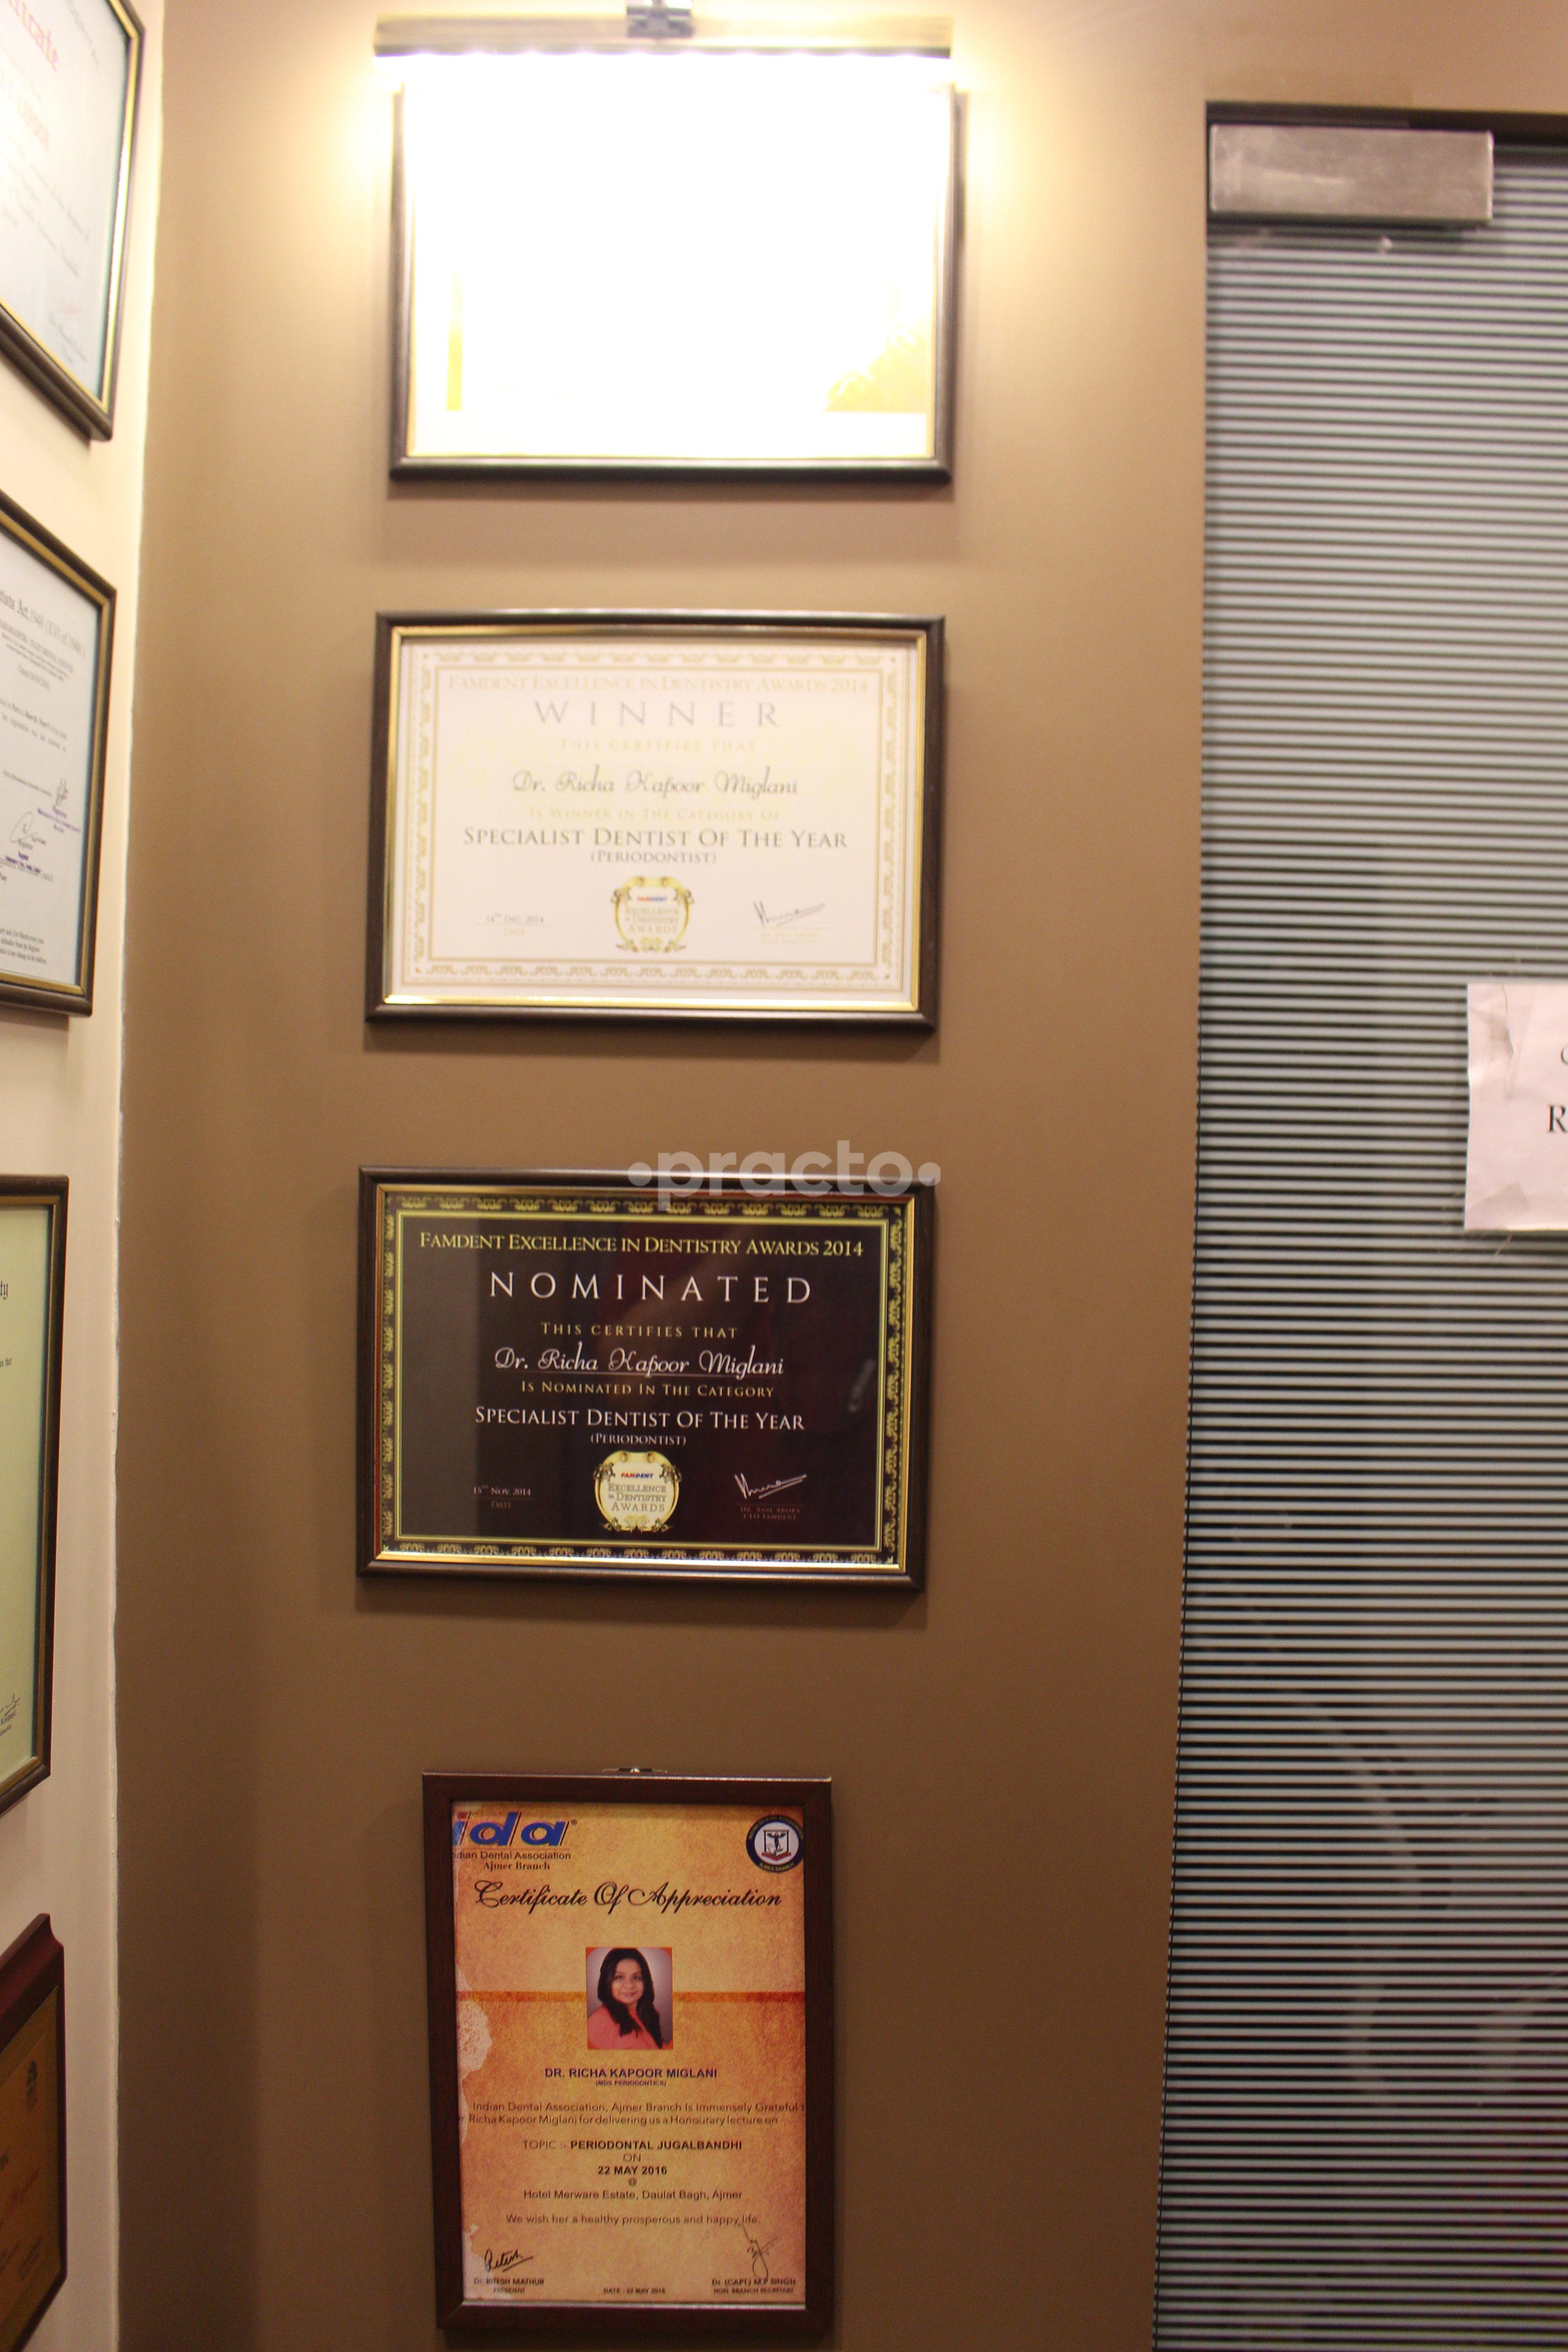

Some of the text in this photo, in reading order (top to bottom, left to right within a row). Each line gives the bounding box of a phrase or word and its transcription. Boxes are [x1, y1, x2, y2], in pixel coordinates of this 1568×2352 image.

[534, 700, 780, 727] WINNER
[511, 763, 799, 800] Dr. Richa Kapoor Miglani
[823, 1240, 863, 1257] 2014
[490, 1271, 812, 1304] NOMINATED
[494, 1340, 784, 1381] Dr. Richa Kapoor Miglani
[611, 1501, 666, 1513] AWARDS
[480, 1851, 512, 1859] Dental
[514, 1851, 571, 1860] Association
[483, 1862, 550, 1872] Ajmer Branch
[474, 1879, 783, 1915] Certificate Of Appreciation
[544, 2068, 718, 2078] DR. RICHA KAPOOR MIGLANI
[473, 2102, 505, 2112] Indian
[508, 2102, 543, 2112] Dental
[611, 2102, 642, 2113] Ajmer
[646, 2102, 681, 2112] Branch
[696, 2102, 752, 2113] Immensely
[755, 2102, 798, 2112] Grateful
[469, 2114, 497, 2124] Richa
[499, 2115, 536, 2126] Kapoor
[539, 2115, 577, 2126] Miglani
[579, 2115, 593, 2124] for
[595, 2115, 647, 2127] delivering
[727, 2115, 763, 2125] lecture
[522, 2140, 557, 2150] TOPIC
[570, 2140, 655, 2150] PERIODONTAL
[657, 2140, 742, 2150] JUGALBANDHI
[623, 2153, 641, 2162] ON
[598, 2166, 667, 2175] 22 MAY 2016
[524, 2190, 550, 2200] Hotel
[554, 2190, 599, 2200] Merware
[642, 2190, 676, 2200] Daulat
[712, 2190, 743, 2201] Ajmer
[505, 2214, 523, 2223] We
[526, 2214, 549, 2223] wish
[552, 2214, 569, 2223] her
[581, 2214, 619, 2226] healthy
[622, 2215, 681, 2226] prosperous
[683, 2215, 703, 2224] and
